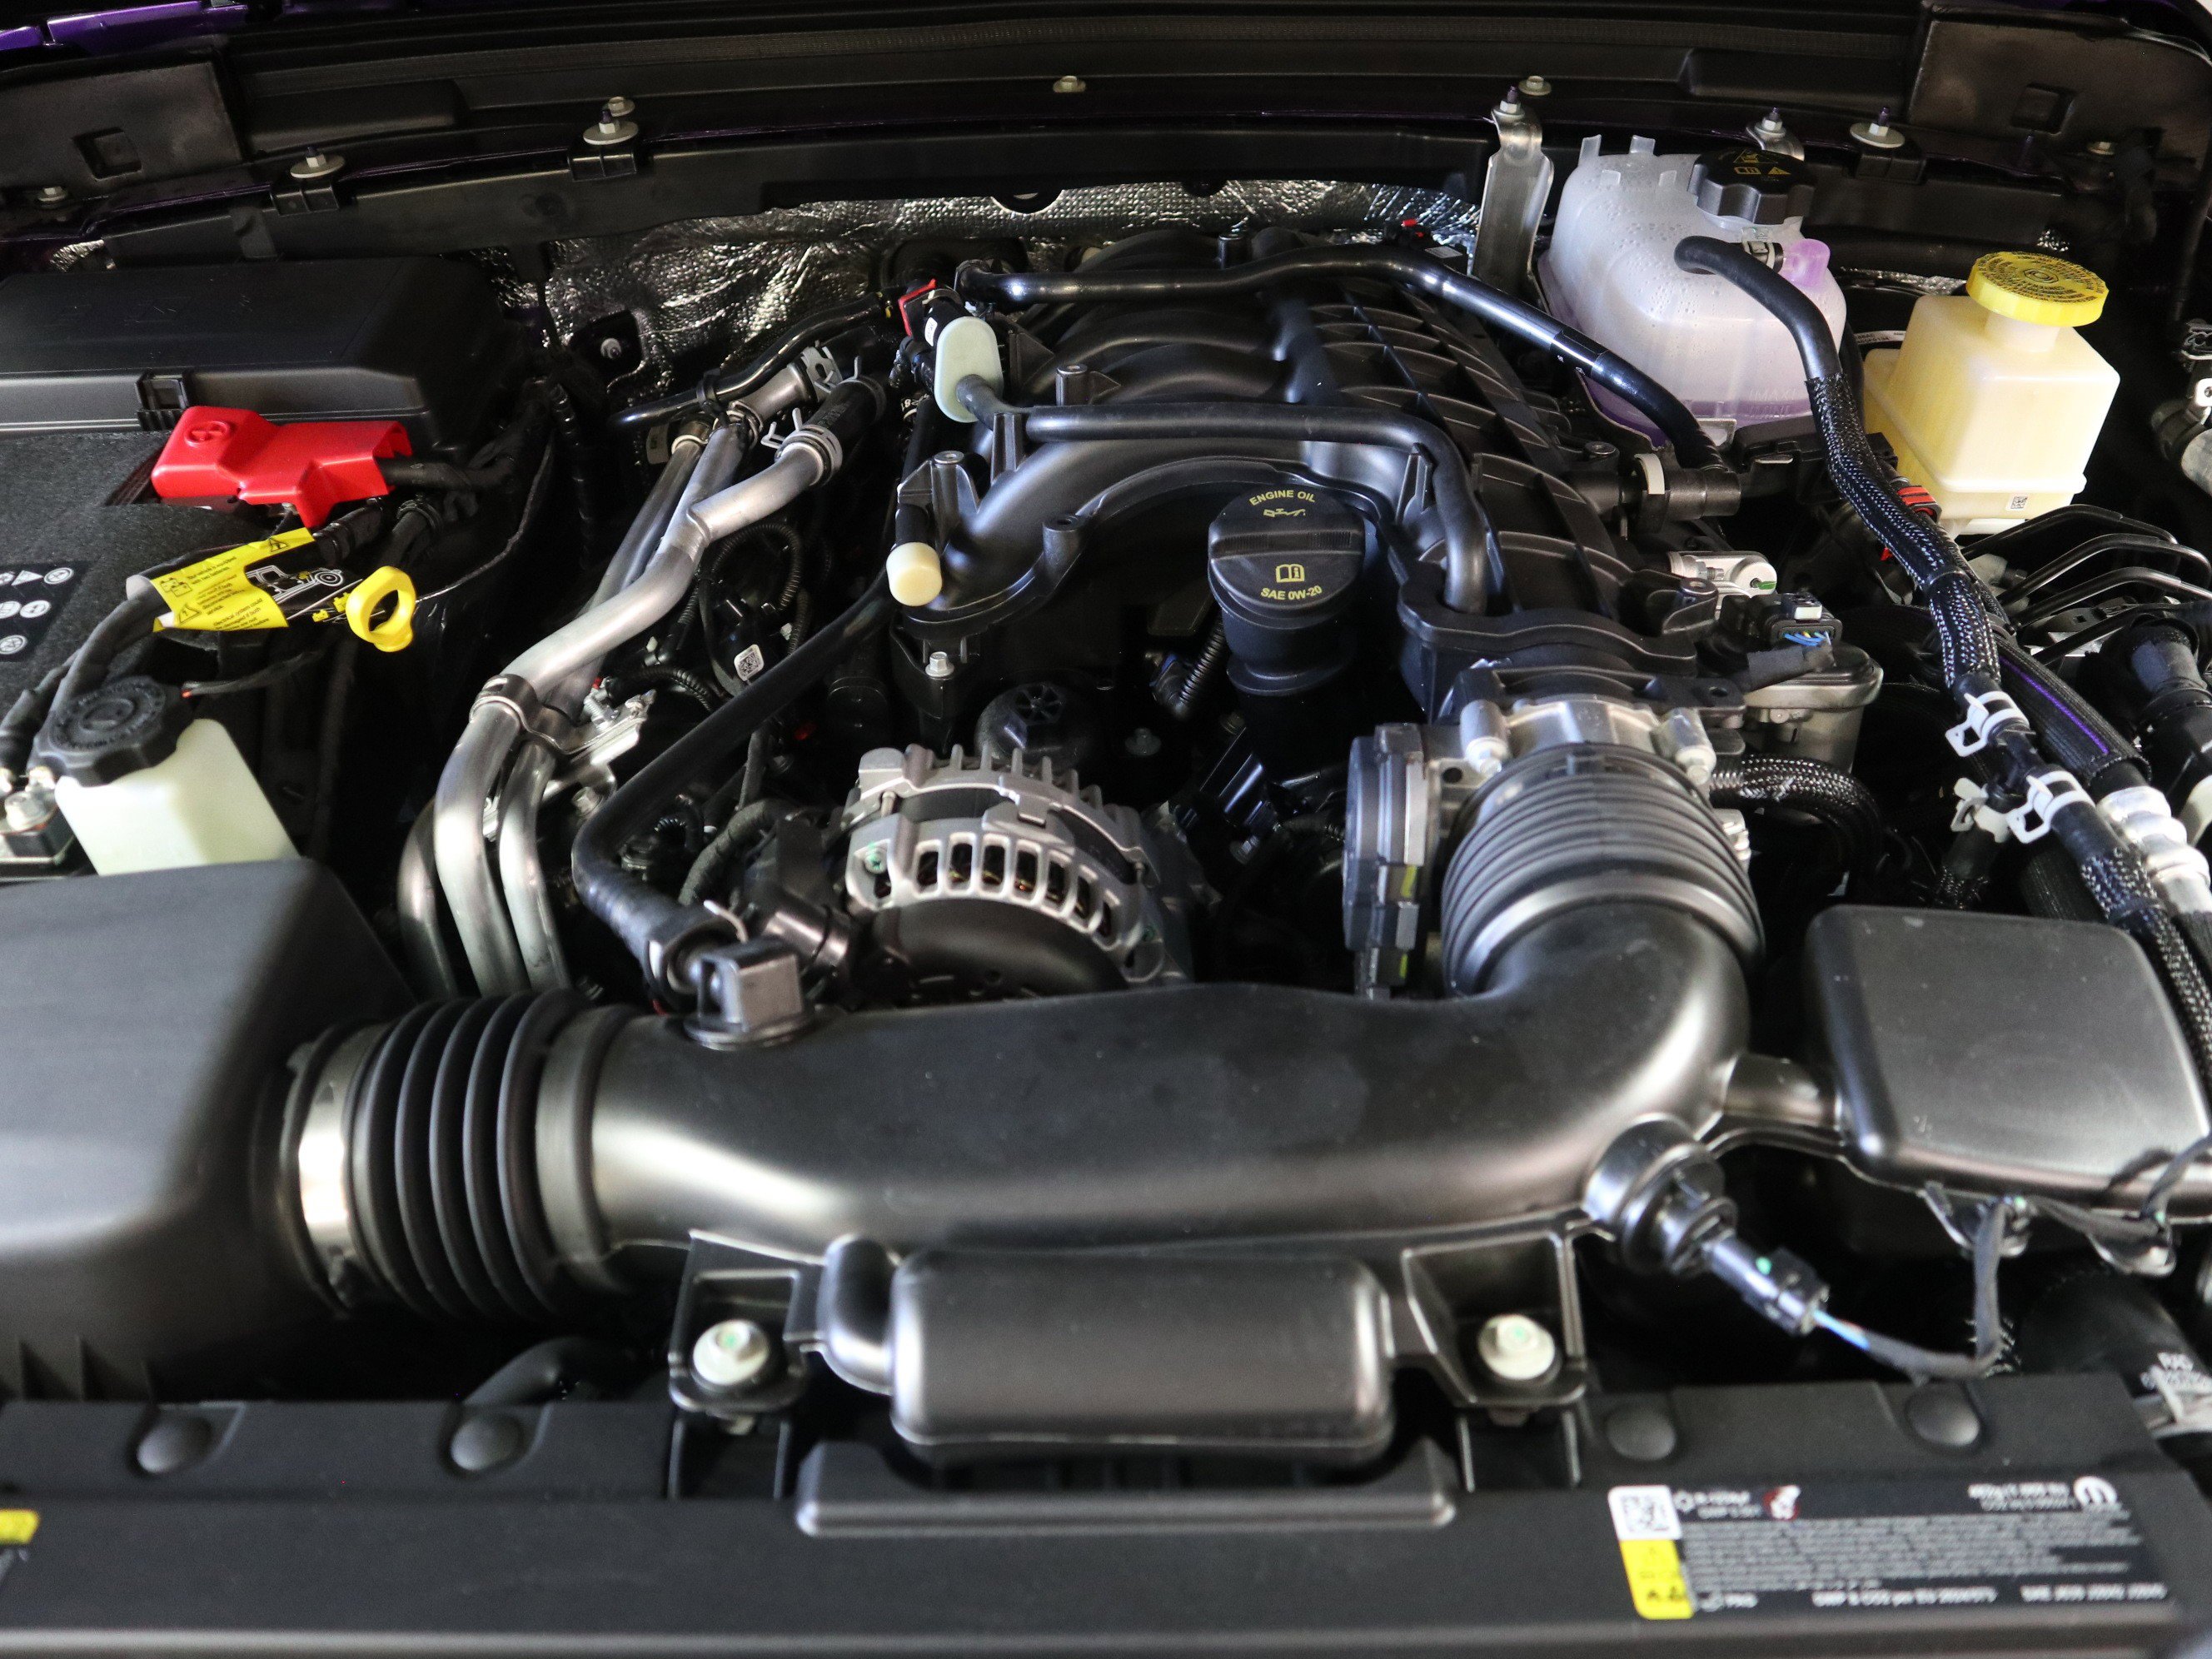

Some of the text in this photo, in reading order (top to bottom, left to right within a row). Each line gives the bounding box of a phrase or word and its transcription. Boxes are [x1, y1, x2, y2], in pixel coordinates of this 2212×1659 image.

[1249, 490, 1316, 506] ENGINE OIL
[1261, 585, 1323, 600] SAE 0W-20
